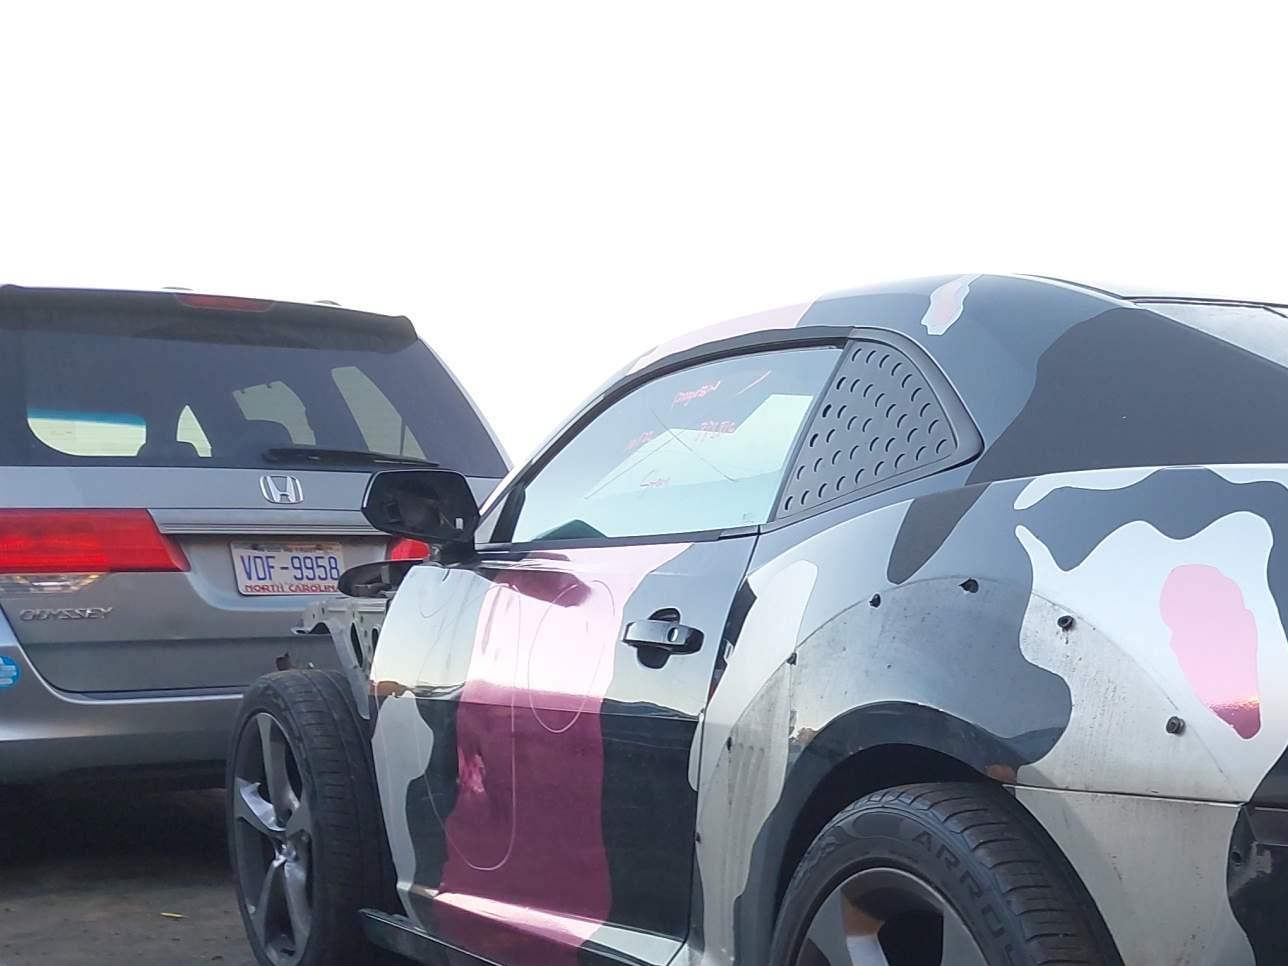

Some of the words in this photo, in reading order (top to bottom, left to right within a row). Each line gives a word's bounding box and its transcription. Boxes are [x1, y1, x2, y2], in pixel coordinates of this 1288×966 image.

[240, 555, 340, 581] VDF-9958
[244, 583, 285, 593] NORTH
[288, 583, 338, 593] CAROLIN
[19, 607, 113, 621] ODYSSEY
